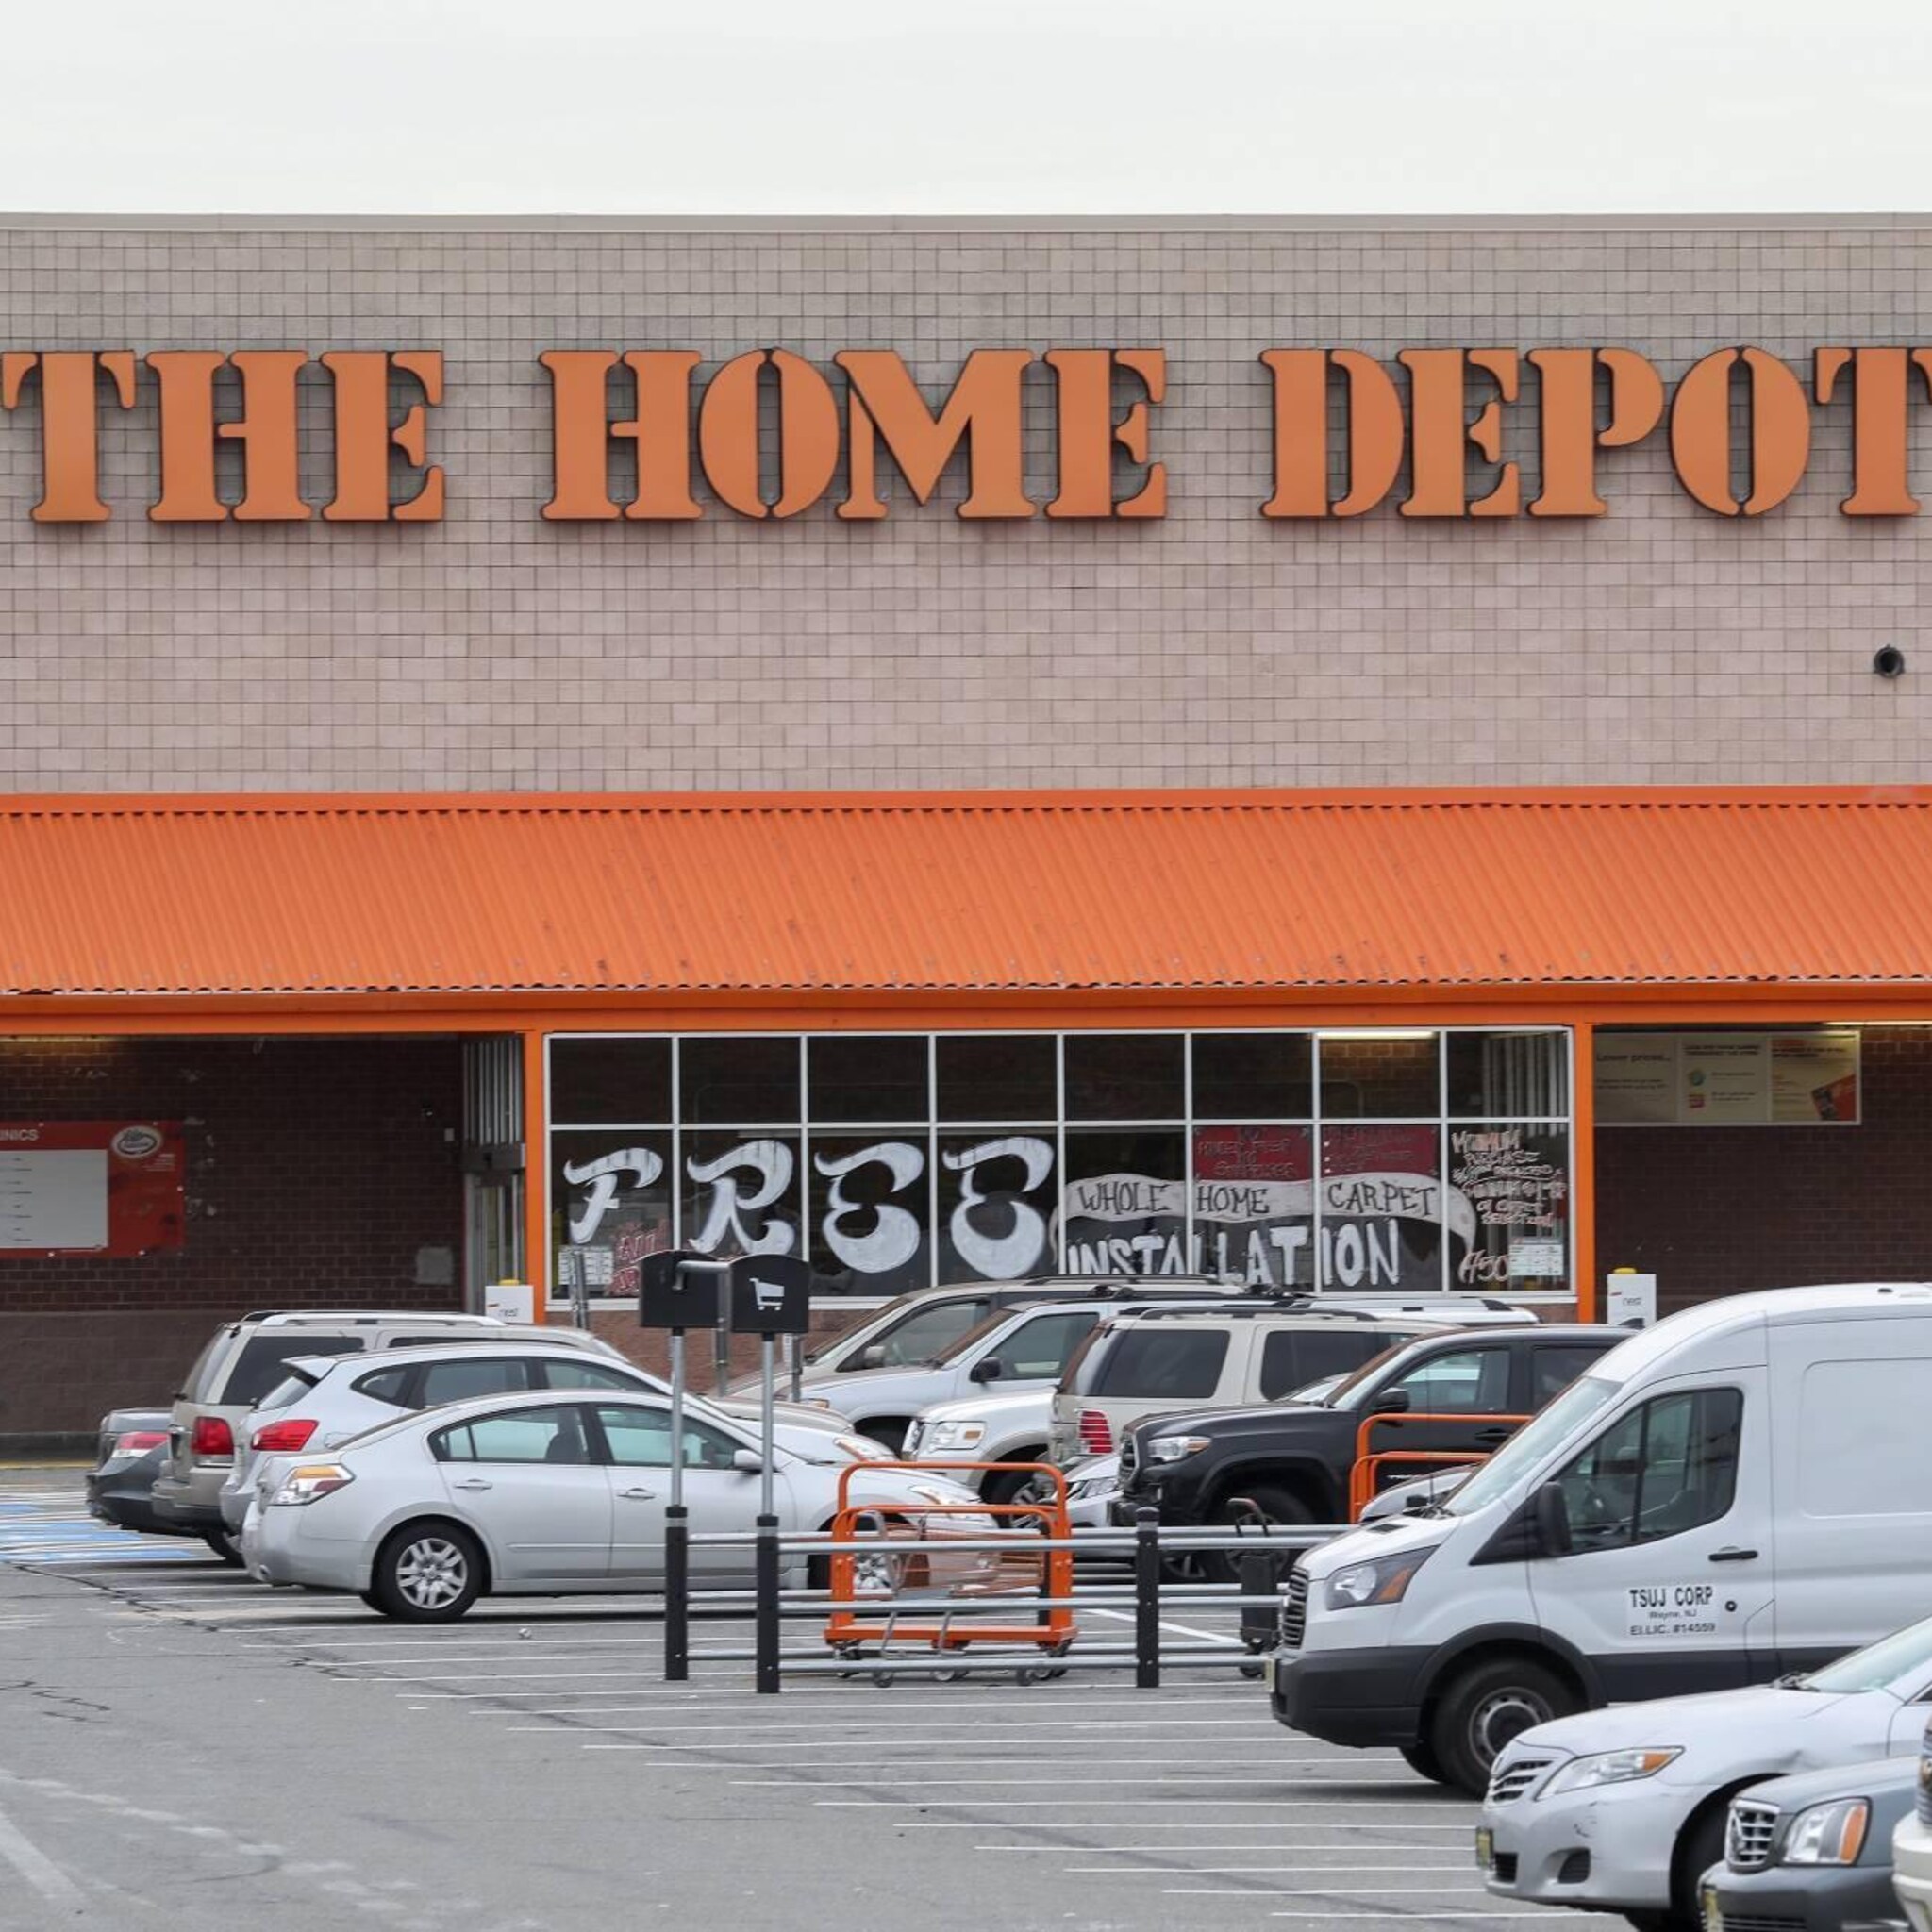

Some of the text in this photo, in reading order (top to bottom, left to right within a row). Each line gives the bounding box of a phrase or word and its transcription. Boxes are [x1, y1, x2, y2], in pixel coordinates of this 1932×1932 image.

[1, 345, 1932, 522] THE HOME DEPOT
[563, 1137, 1054, 1280] FREE
[1078, 1181, 1437, 1217] WHOLE HOME CARPET
[1068, 1218, 1400, 1287] INSTALLATION
[1629, 1585, 1713, 1608] TSUJ CORP
